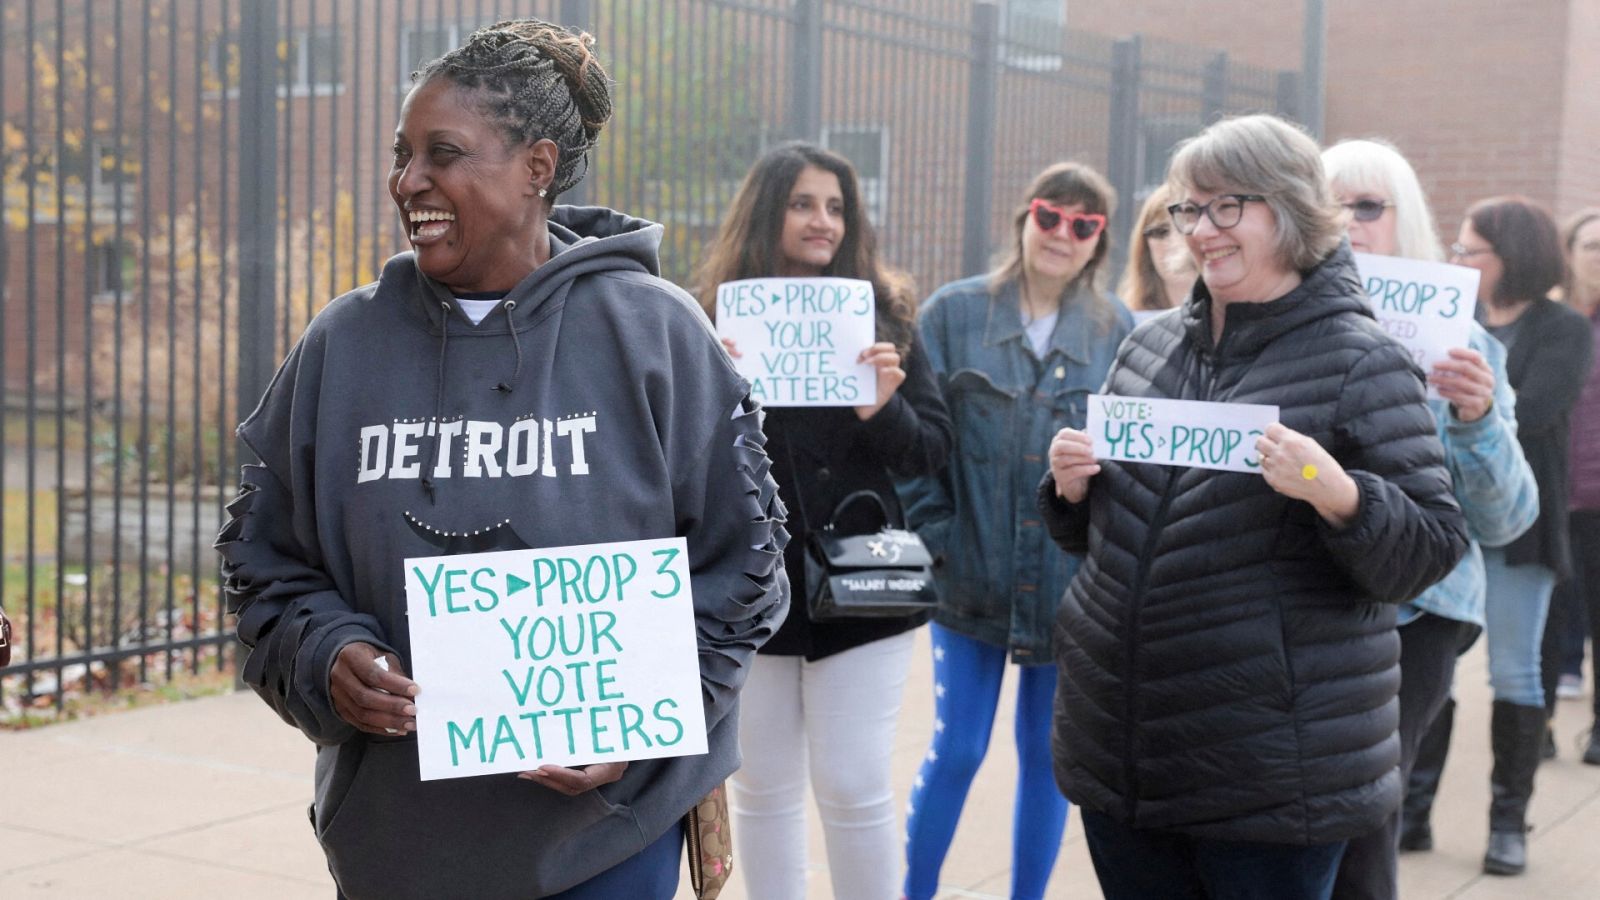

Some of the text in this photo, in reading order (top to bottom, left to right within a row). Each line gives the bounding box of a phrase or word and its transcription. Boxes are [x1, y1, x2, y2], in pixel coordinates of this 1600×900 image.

[722, 284, 869, 317] YES PROP 3
[1367, 278, 1460, 318] PROP 3
[765, 320, 834, 349] YOUR
[1380, 320, 1417, 340] CED
[761, 351, 836, 375] VOTE
[752, 376, 858, 401] ATTERS
[1102, 401, 1152, 420] VOTE:
[358, 418, 596, 484] DETROIT
[1105, 420, 1154, 459] YES
[1170, 425, 1241, 464] PROP
[413, 548, 681, 616] YES PROP 3
[500, 611, 623, 660] YOUR
[503, 659, 624, 706] VOTE
[447, 698, 683, 766] MATTERS
